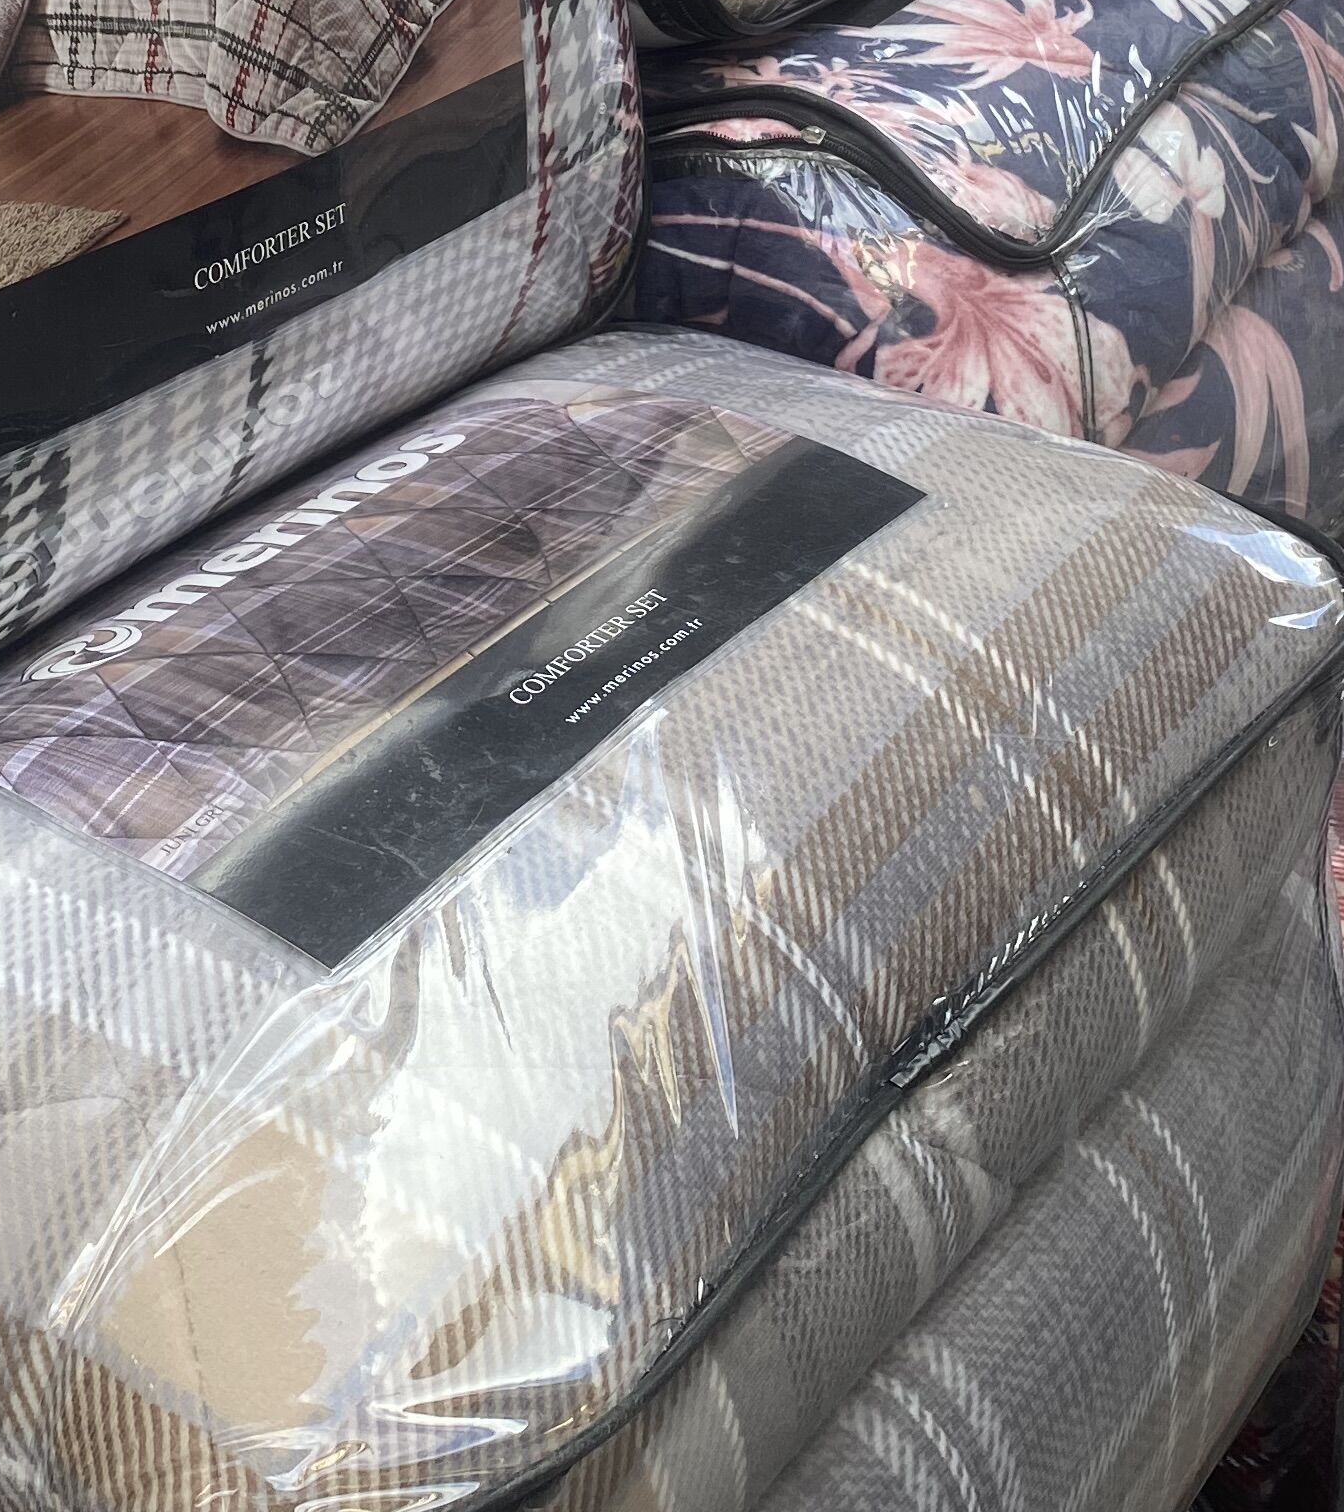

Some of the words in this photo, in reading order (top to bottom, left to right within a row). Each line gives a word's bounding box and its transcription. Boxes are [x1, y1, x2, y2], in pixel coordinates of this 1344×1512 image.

[193, 221, 312, 290] COMFORTER
[314, 202, 347, 235] SET
[205, 259, 344, 335] www.merinos.com.tr
[113, 430, 466, 622] merinos
[509, 615, 635, 705] COMFORTER
[624, 588, 668, 619] SET
[565, 617, 704, 724] www.merinos.com.tr
